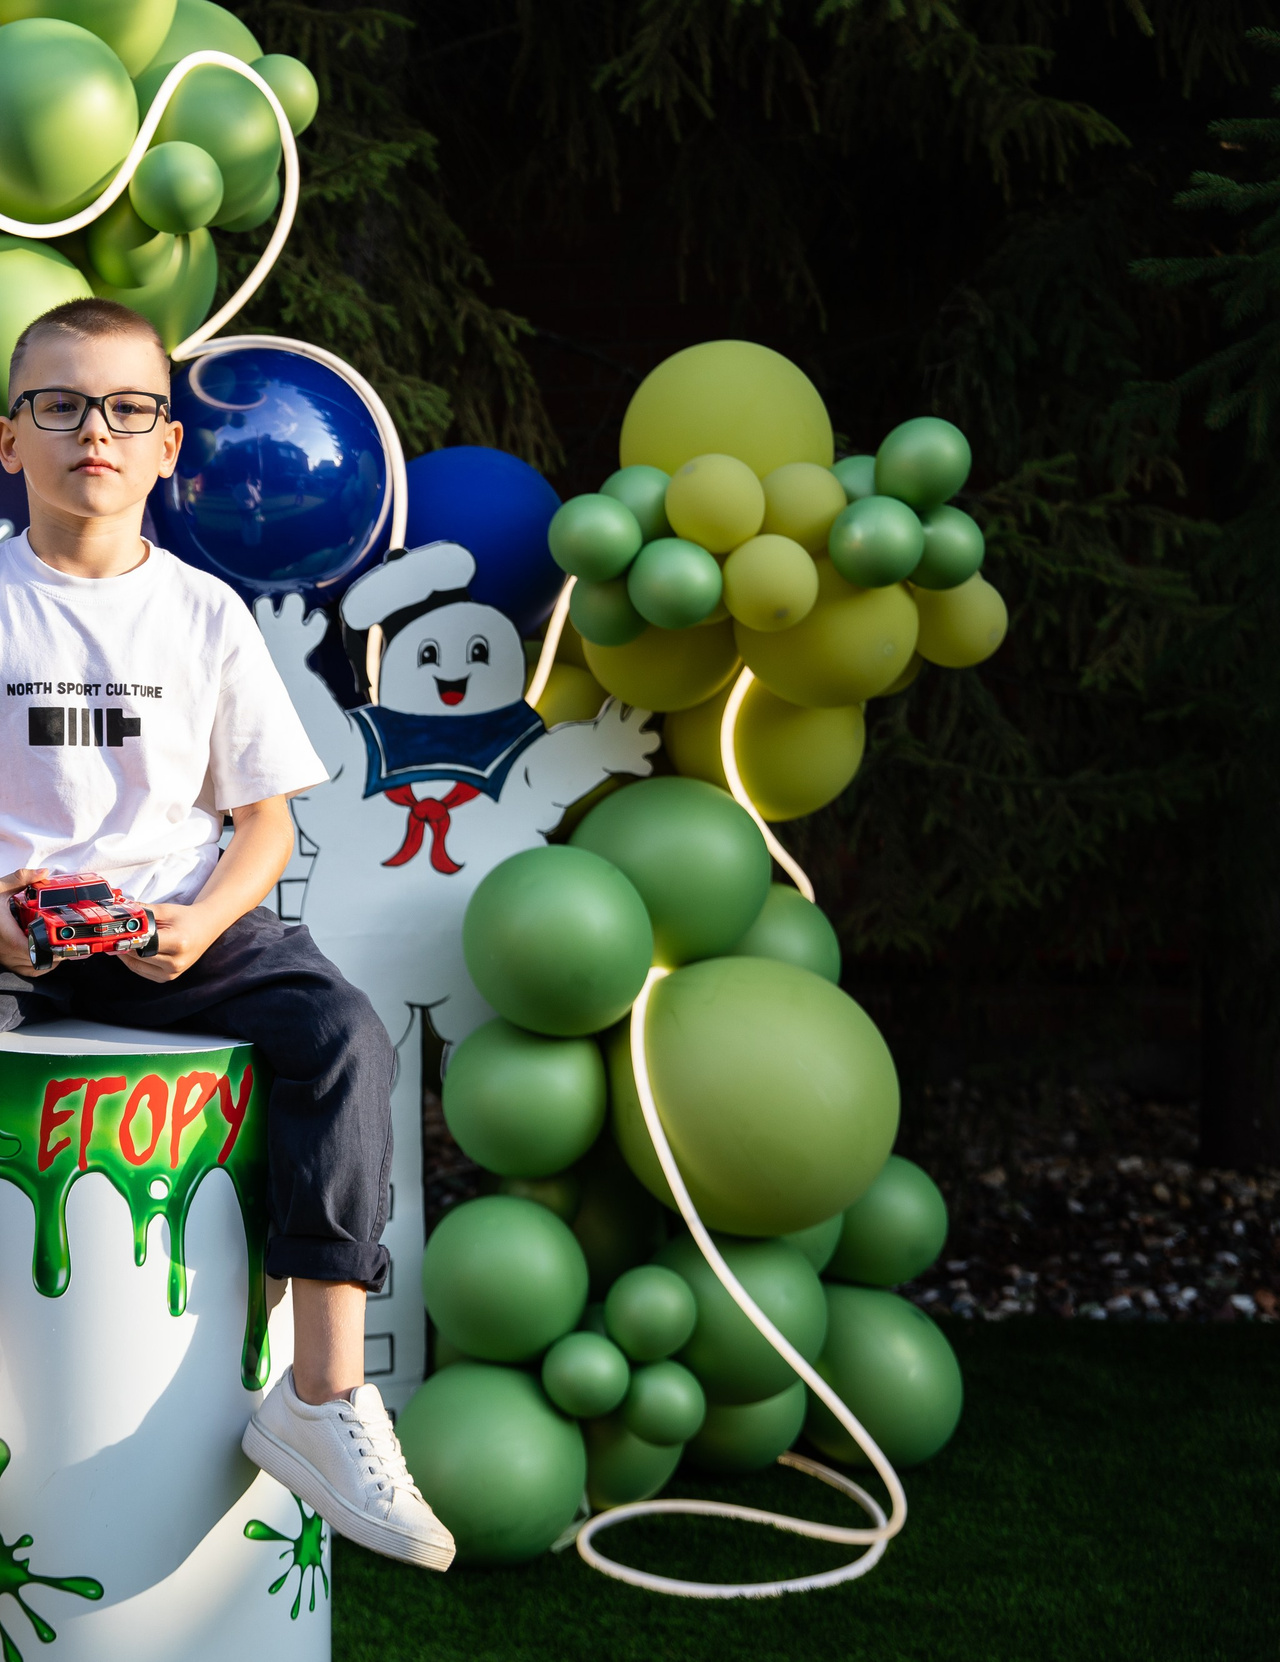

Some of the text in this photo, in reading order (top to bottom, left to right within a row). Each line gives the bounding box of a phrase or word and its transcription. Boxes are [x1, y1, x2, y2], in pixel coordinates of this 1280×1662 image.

[6, 681, 163, 699] NORTH SPORT CULTURE
[37, 1063, 254, 1173] ЕГОРУ
